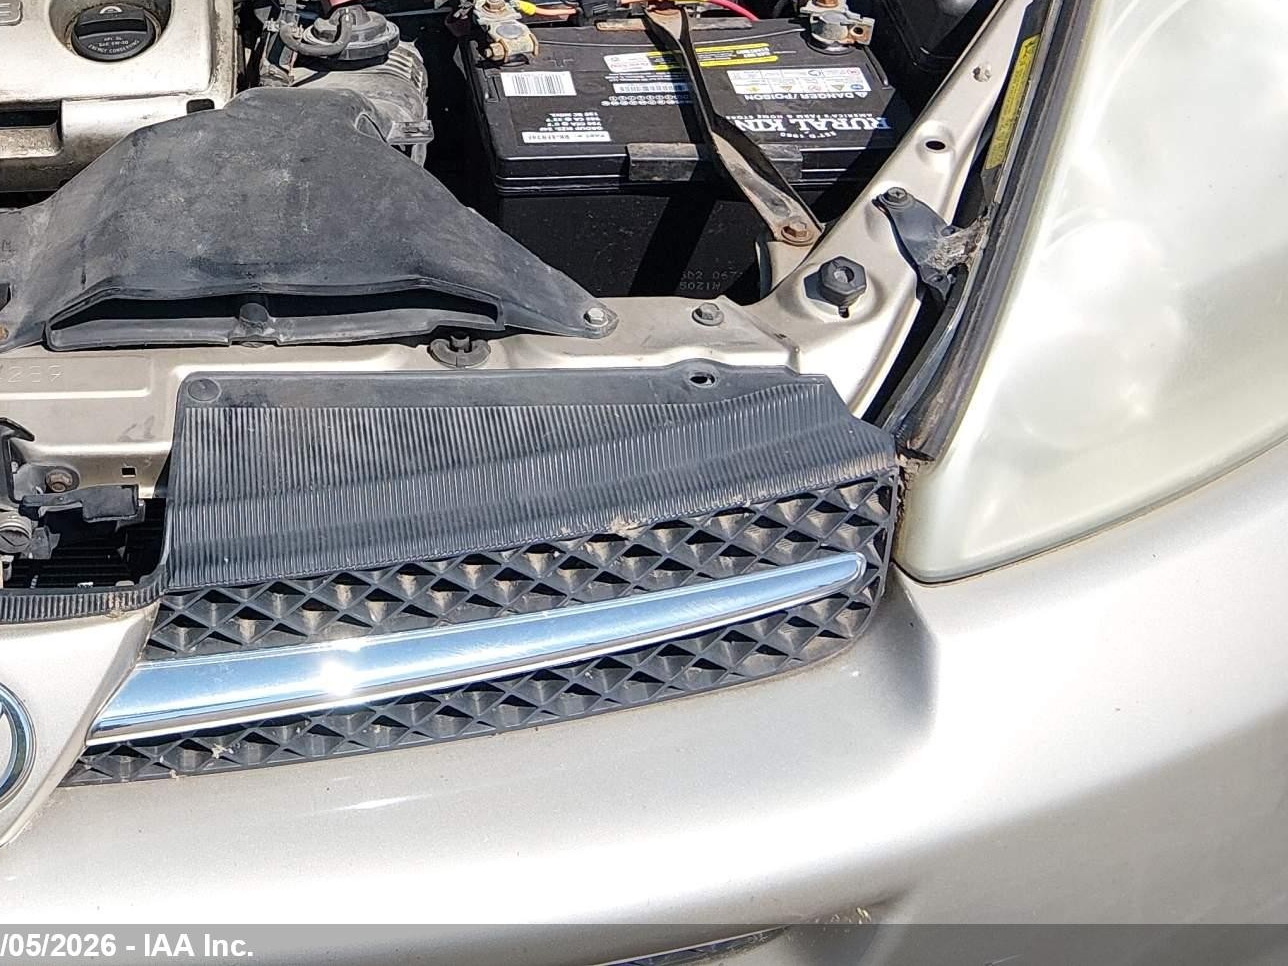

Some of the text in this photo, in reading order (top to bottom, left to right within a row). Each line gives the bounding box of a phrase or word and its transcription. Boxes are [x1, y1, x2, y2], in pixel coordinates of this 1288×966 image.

[800, 92, 854, 100] DANGER
[733, 117, 893, 132] RURAL KIN
